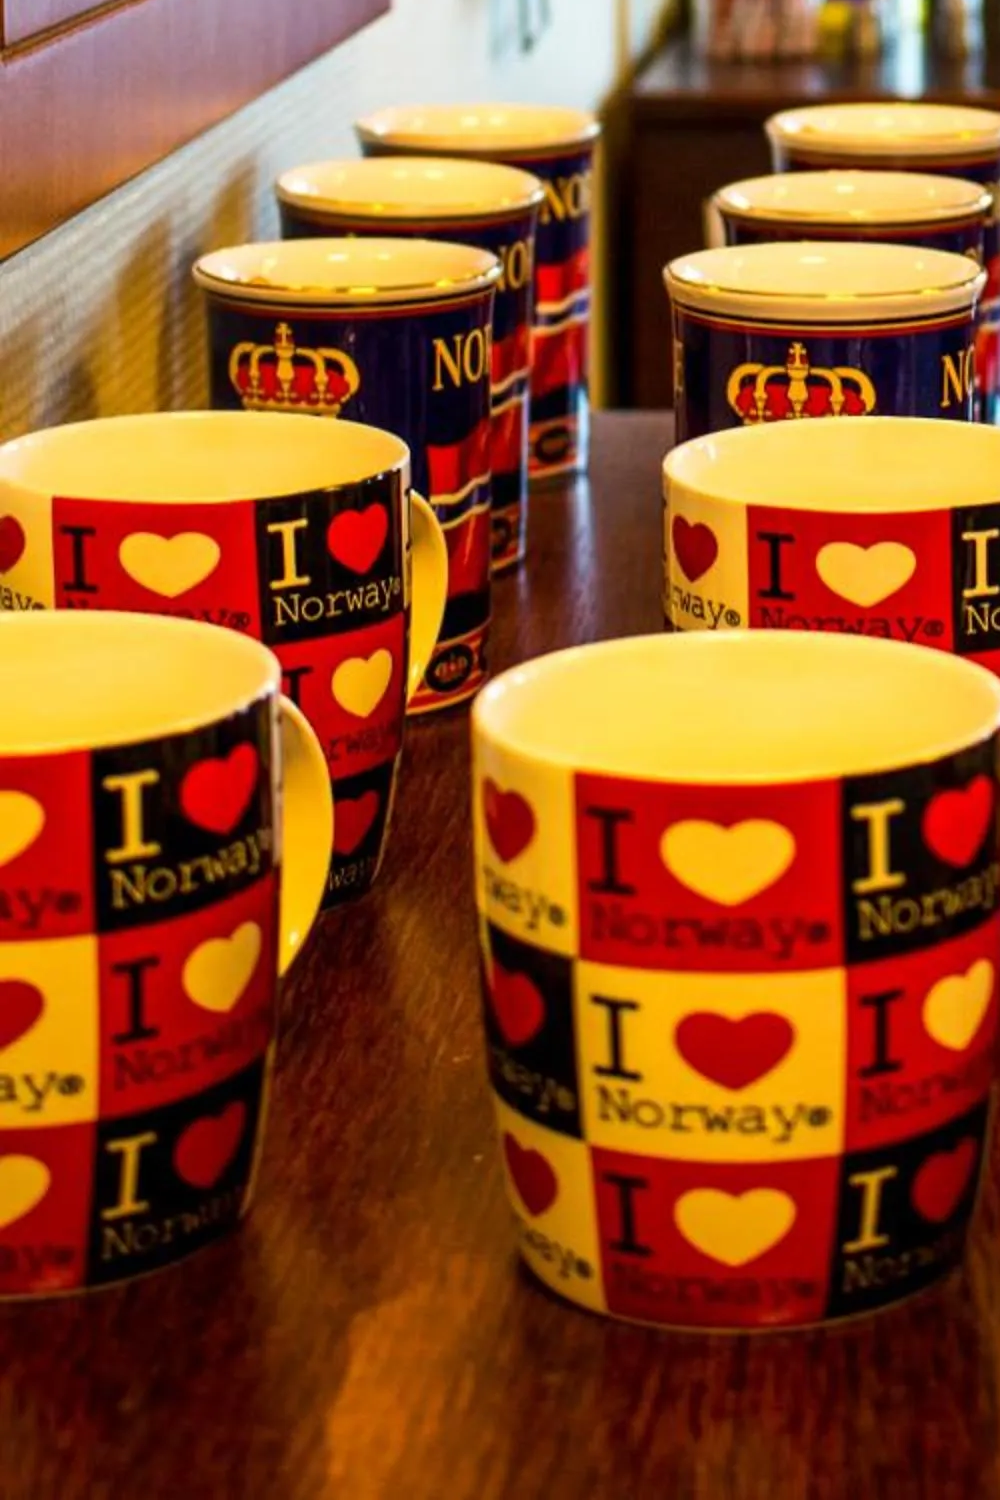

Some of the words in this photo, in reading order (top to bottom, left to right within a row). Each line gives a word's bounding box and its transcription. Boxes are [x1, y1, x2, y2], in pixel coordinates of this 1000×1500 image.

[60, 524, 97, 593] I
[266, 516, 312, 591] I
[756, 531, 795, 600] I
[961, 527, 1000, 599] I
[101, 768, 161, 863] I
[586, 802, 637, 896] I
[849, 797, 907, 896] I
[111, 956, 159, 1044] I
[590, 994, 642, 1080] I
[857, 985, 906, 1079] I
[103, 1129, 158, 1221] I
[601, 1171, 654, 1257] I
[840, 1164, 899, 1254] I
